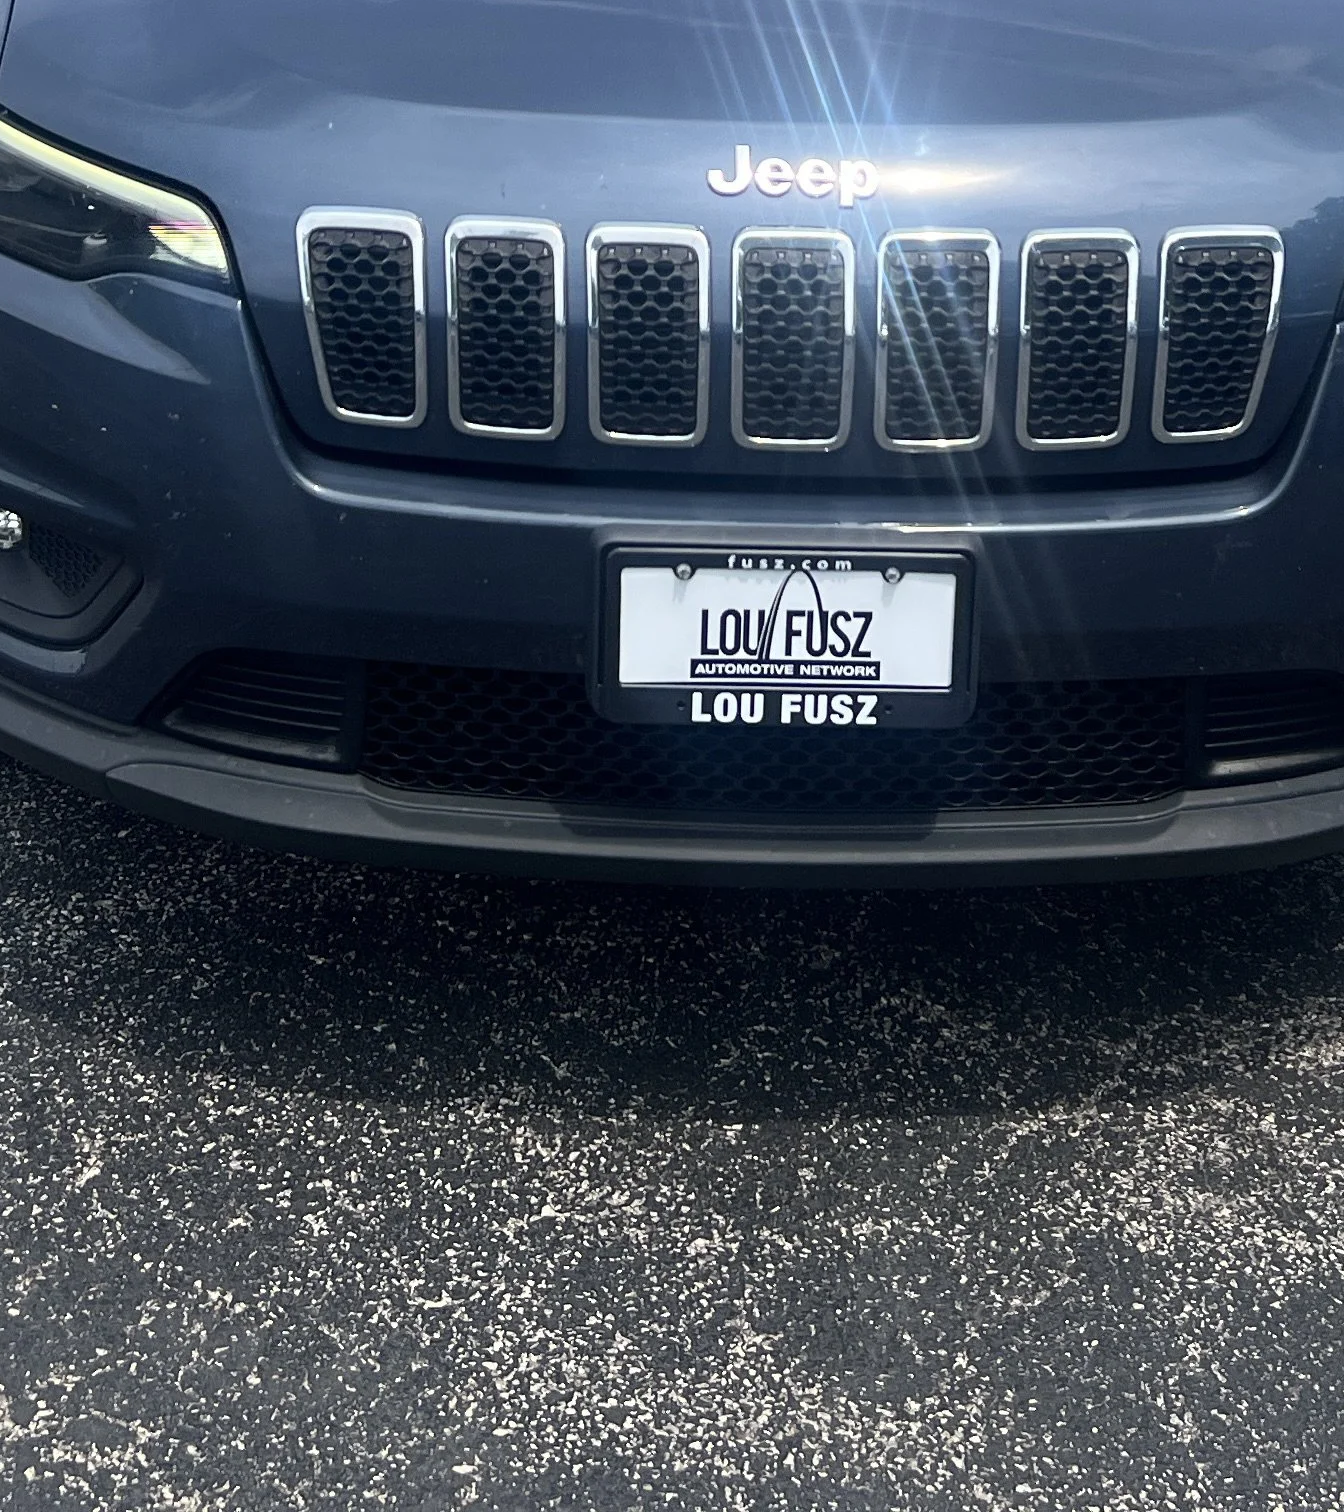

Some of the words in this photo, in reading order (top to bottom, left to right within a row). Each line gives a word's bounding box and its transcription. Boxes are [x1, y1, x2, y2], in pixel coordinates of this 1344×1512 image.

[706, 144, 880, 208] Jeep
[727, 554, 853, 571] fusz.com
[701, 609, 767, 657] LOU
[784, 609, 874, 658] FUSZ
[694, 663, 795, 676] AUTOMOTIVE
[799, 664, 878, 678] NETWORK
[691, 692, 764, 724] LOU
[780, 693, 879, 726] FUSZ
